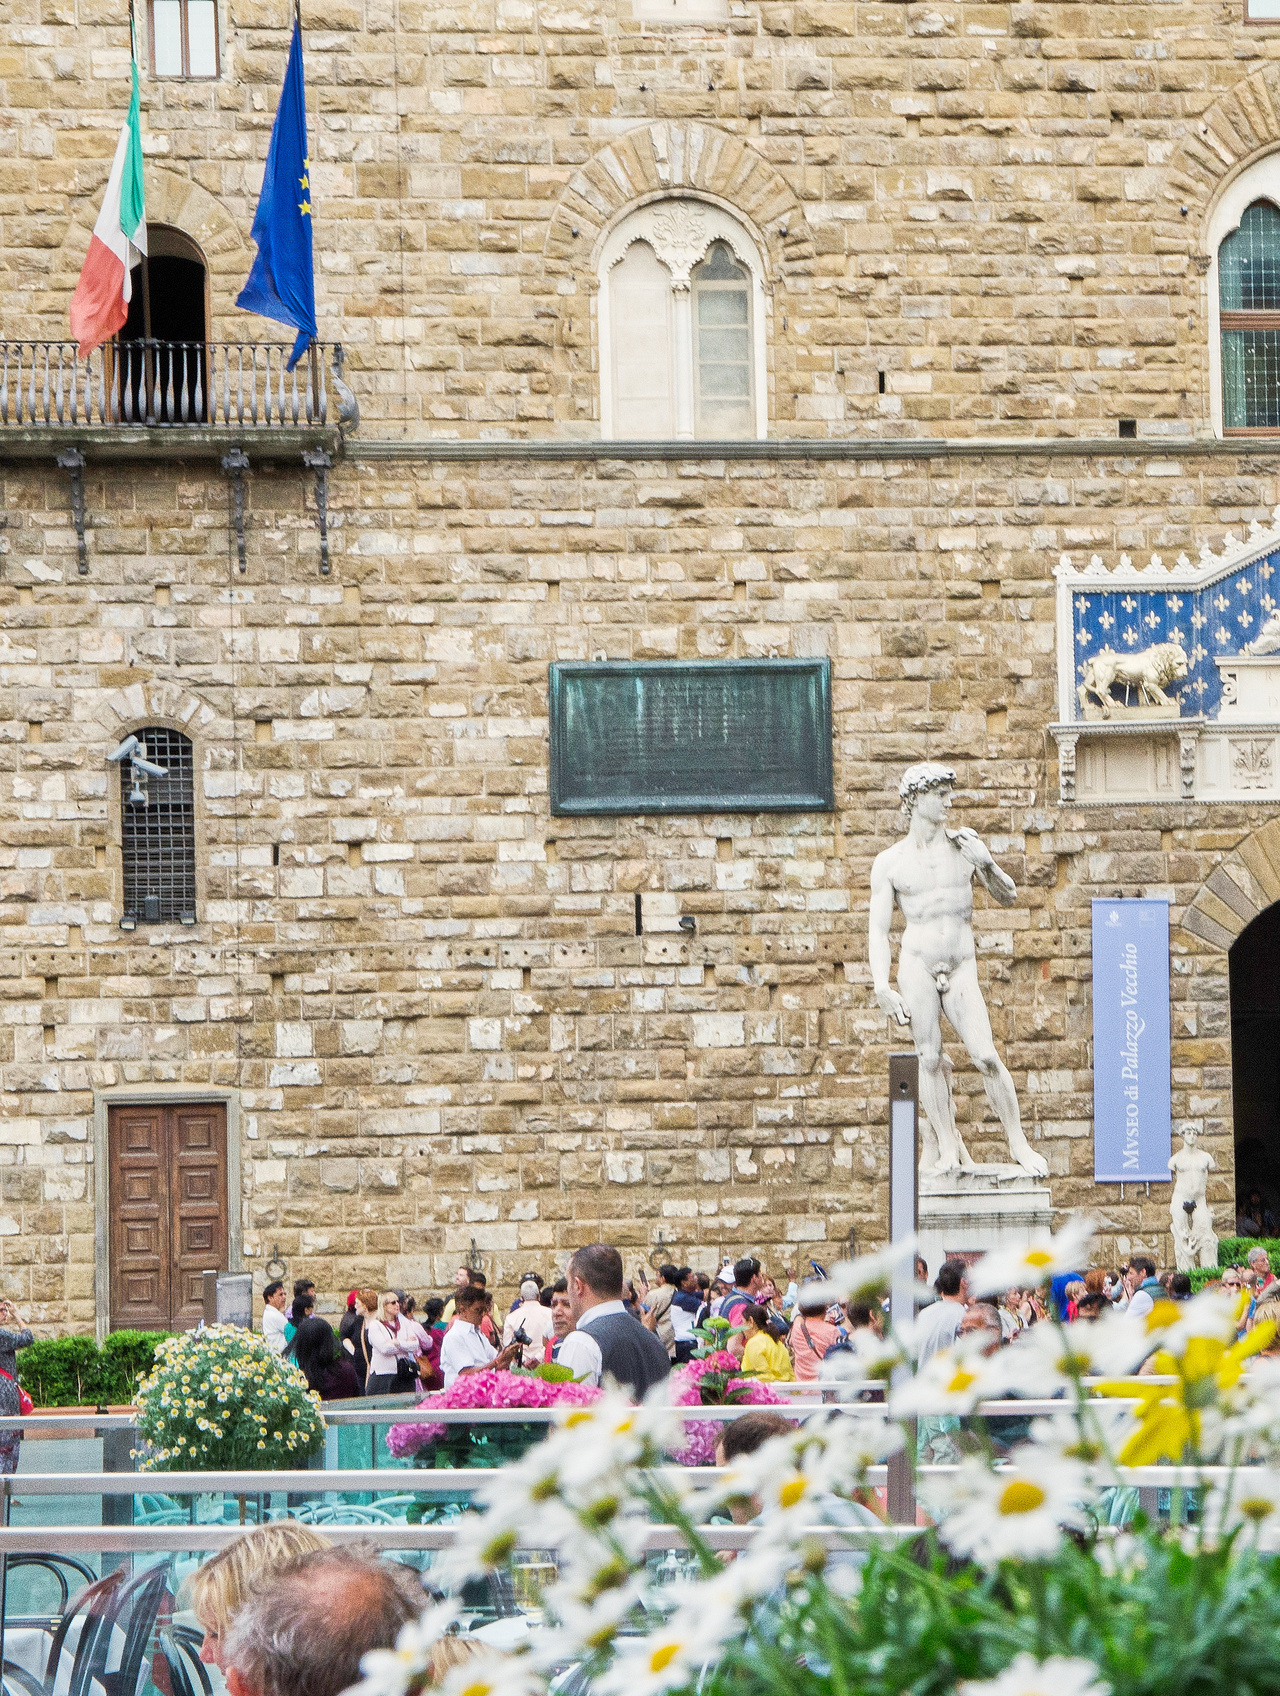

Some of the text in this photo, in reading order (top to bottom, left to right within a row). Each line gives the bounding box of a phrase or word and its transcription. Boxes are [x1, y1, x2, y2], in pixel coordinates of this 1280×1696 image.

[1119, 943, 1138, 1007] Vecchio
[1120, 1009, 1146, 1081] Palazzo
[1123, 1085, 1139, 1100] di
